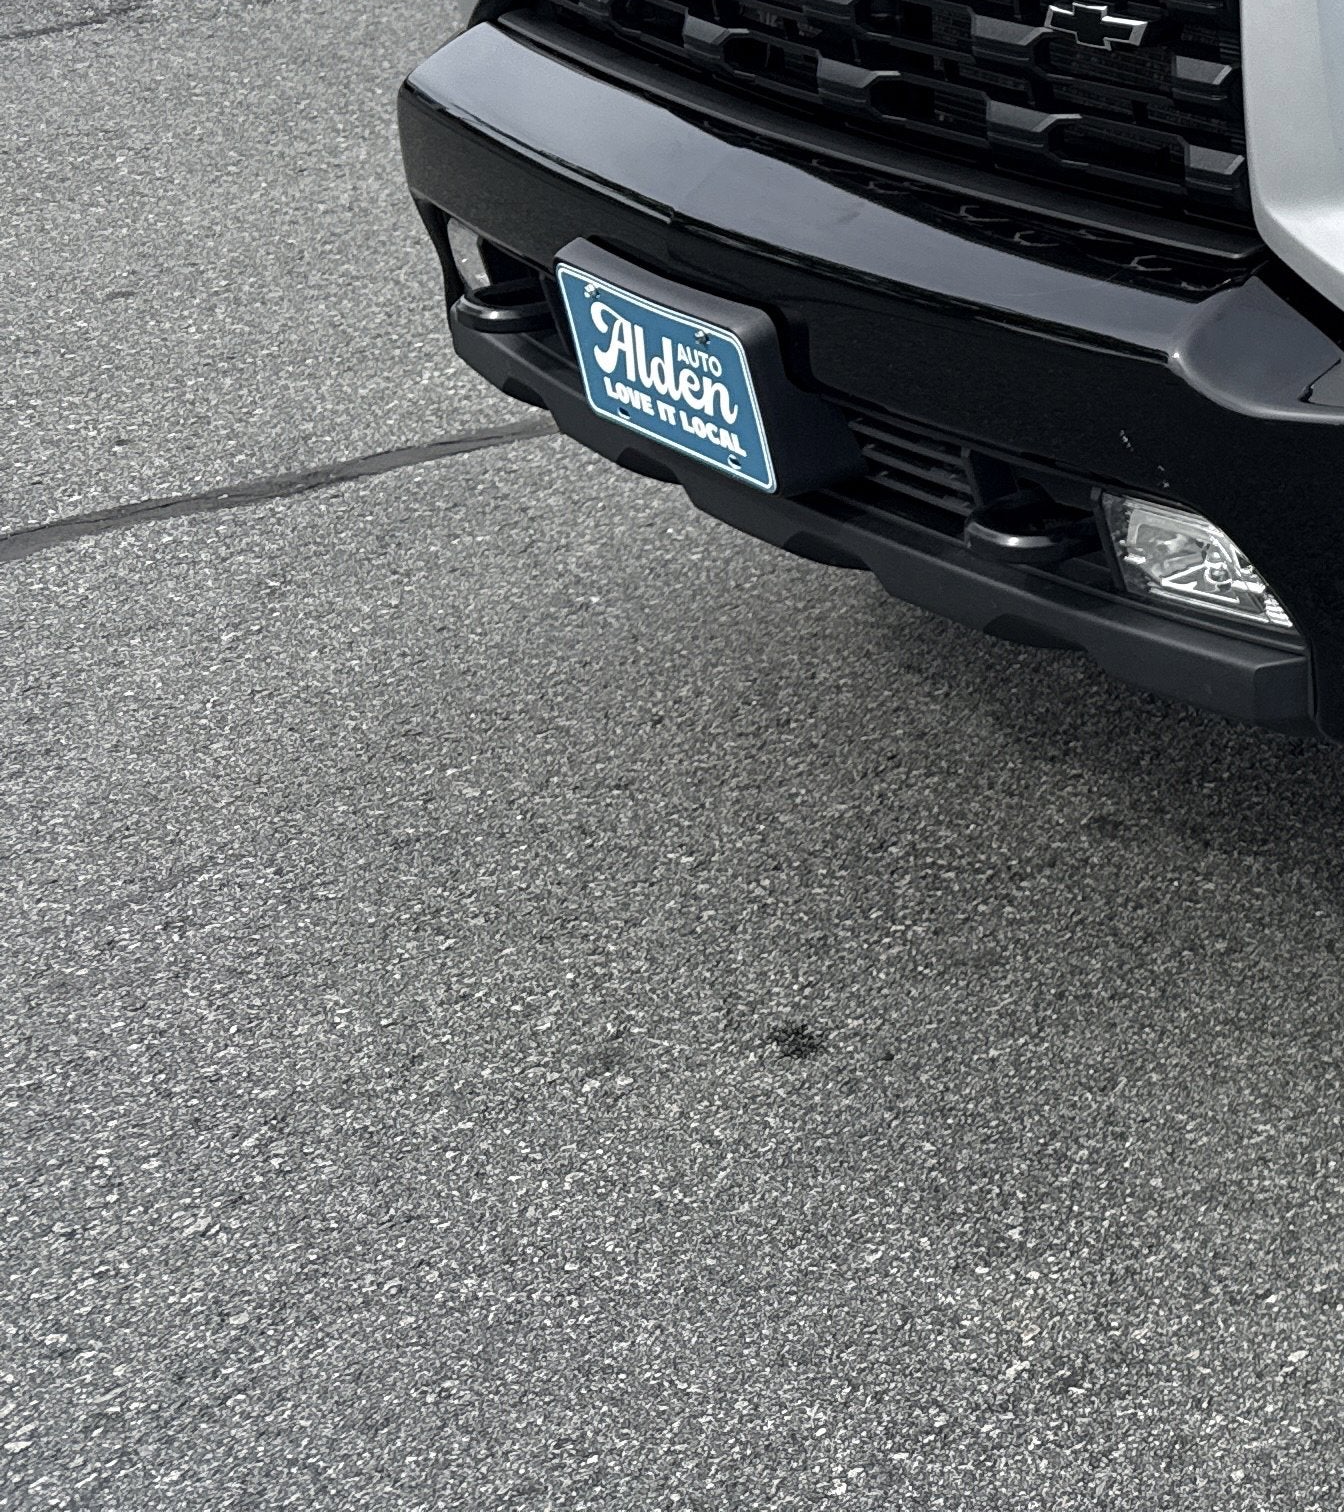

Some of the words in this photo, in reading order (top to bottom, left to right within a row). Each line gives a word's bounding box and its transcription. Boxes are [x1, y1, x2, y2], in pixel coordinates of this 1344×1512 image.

[590, 301, 738, 425] Alden
[676, 343, 723, 376] AUTO
[603, 377, 654, 416] LOVE
[657, 399, 677, 426] IT
[680, 410, 747, 457] LOCAL
